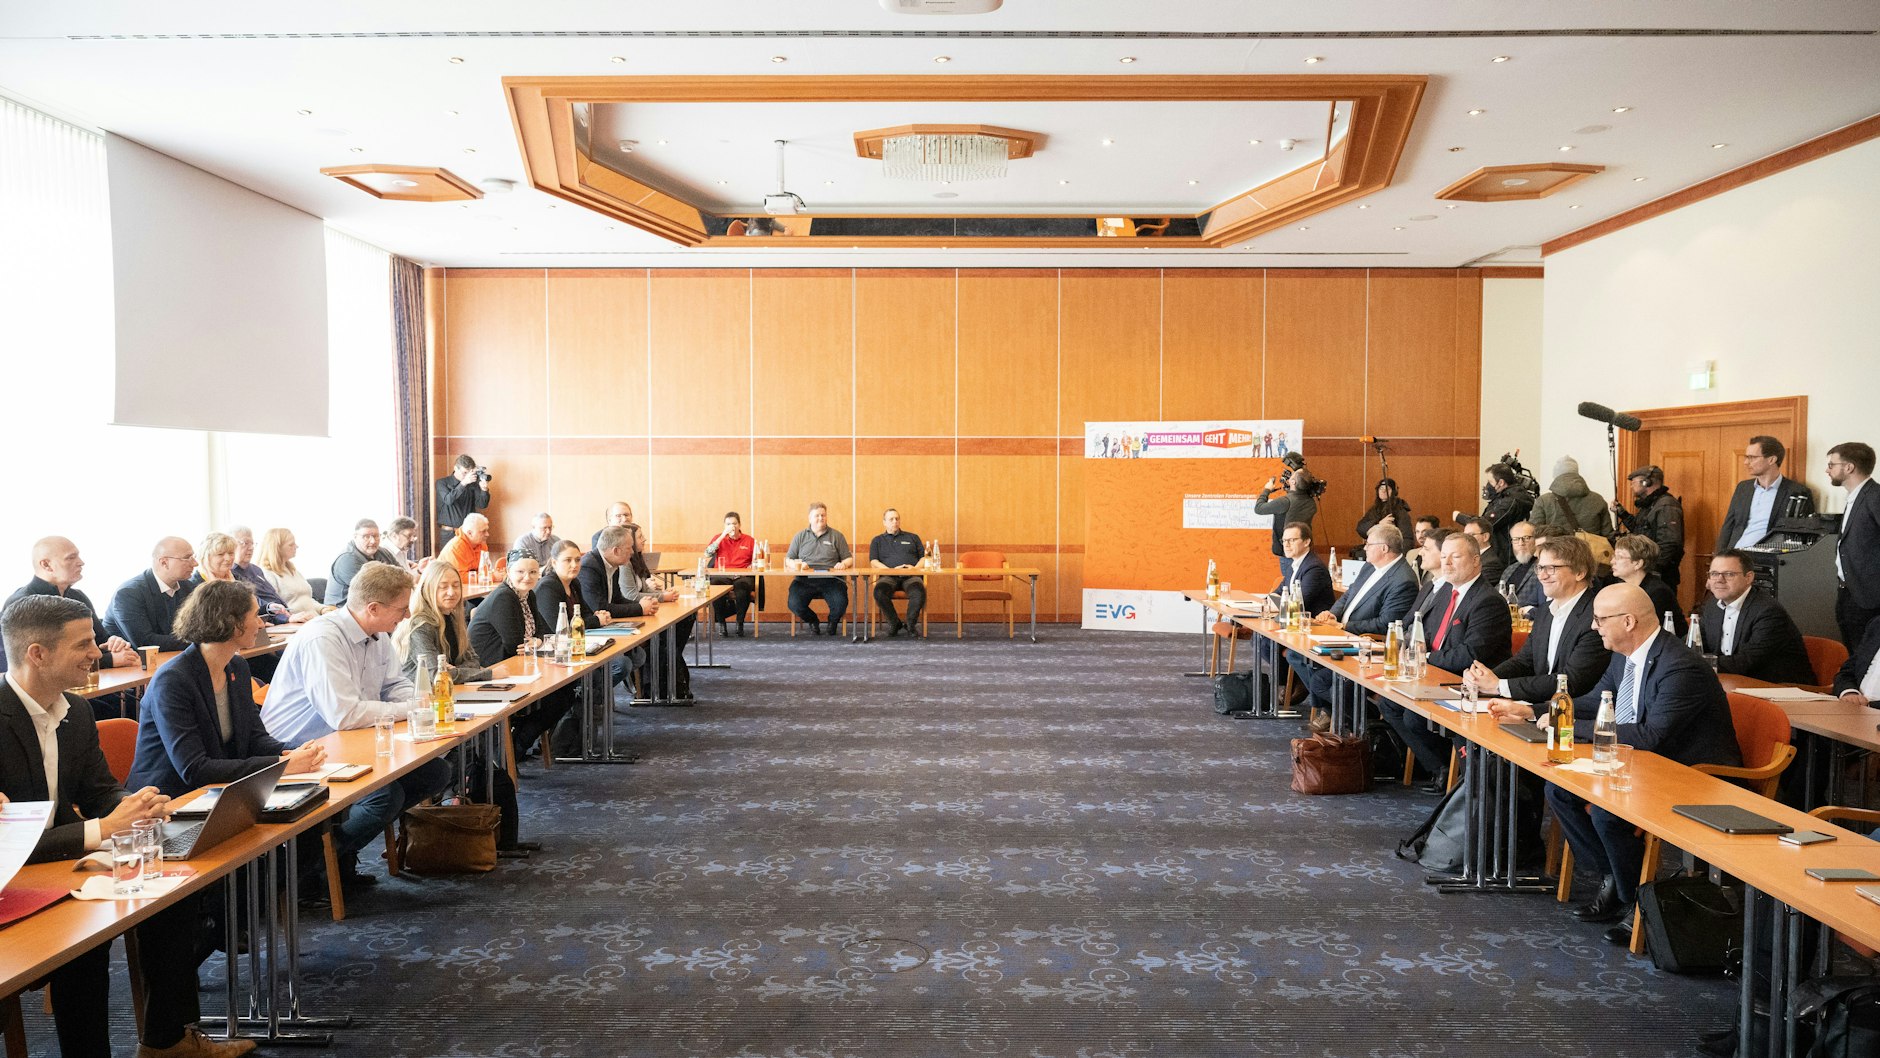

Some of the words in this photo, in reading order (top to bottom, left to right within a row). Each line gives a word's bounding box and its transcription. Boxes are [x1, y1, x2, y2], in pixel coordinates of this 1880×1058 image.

[1149, 434, 1200, 444] GEMEINSAM
[1204, 433, 1226, 444] GEHT
[1096, 603, 1136, 619] EVG
